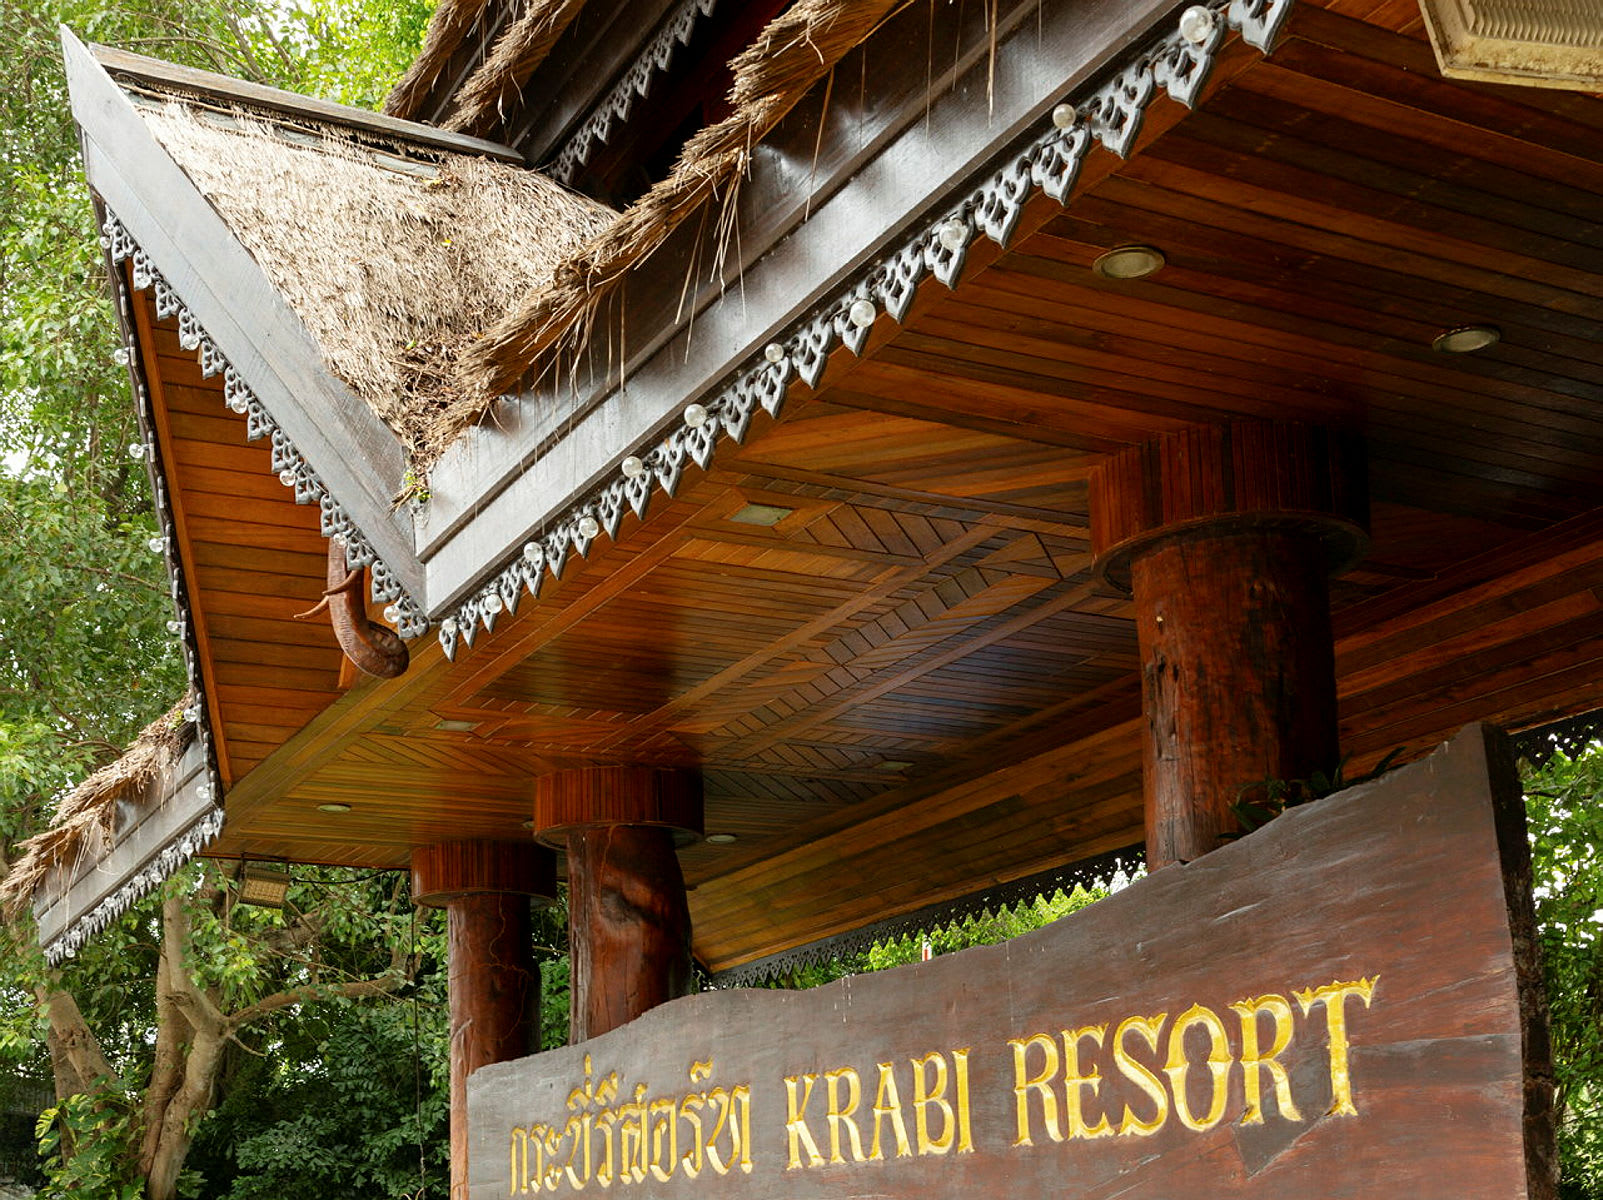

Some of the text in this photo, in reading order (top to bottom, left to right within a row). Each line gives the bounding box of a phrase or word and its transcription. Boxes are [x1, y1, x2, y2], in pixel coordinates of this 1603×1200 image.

[511, 1053, 753, 1197] กระบี่รีสอร์ท
[784, 975, 1381, 1171] KRABI RESORT
